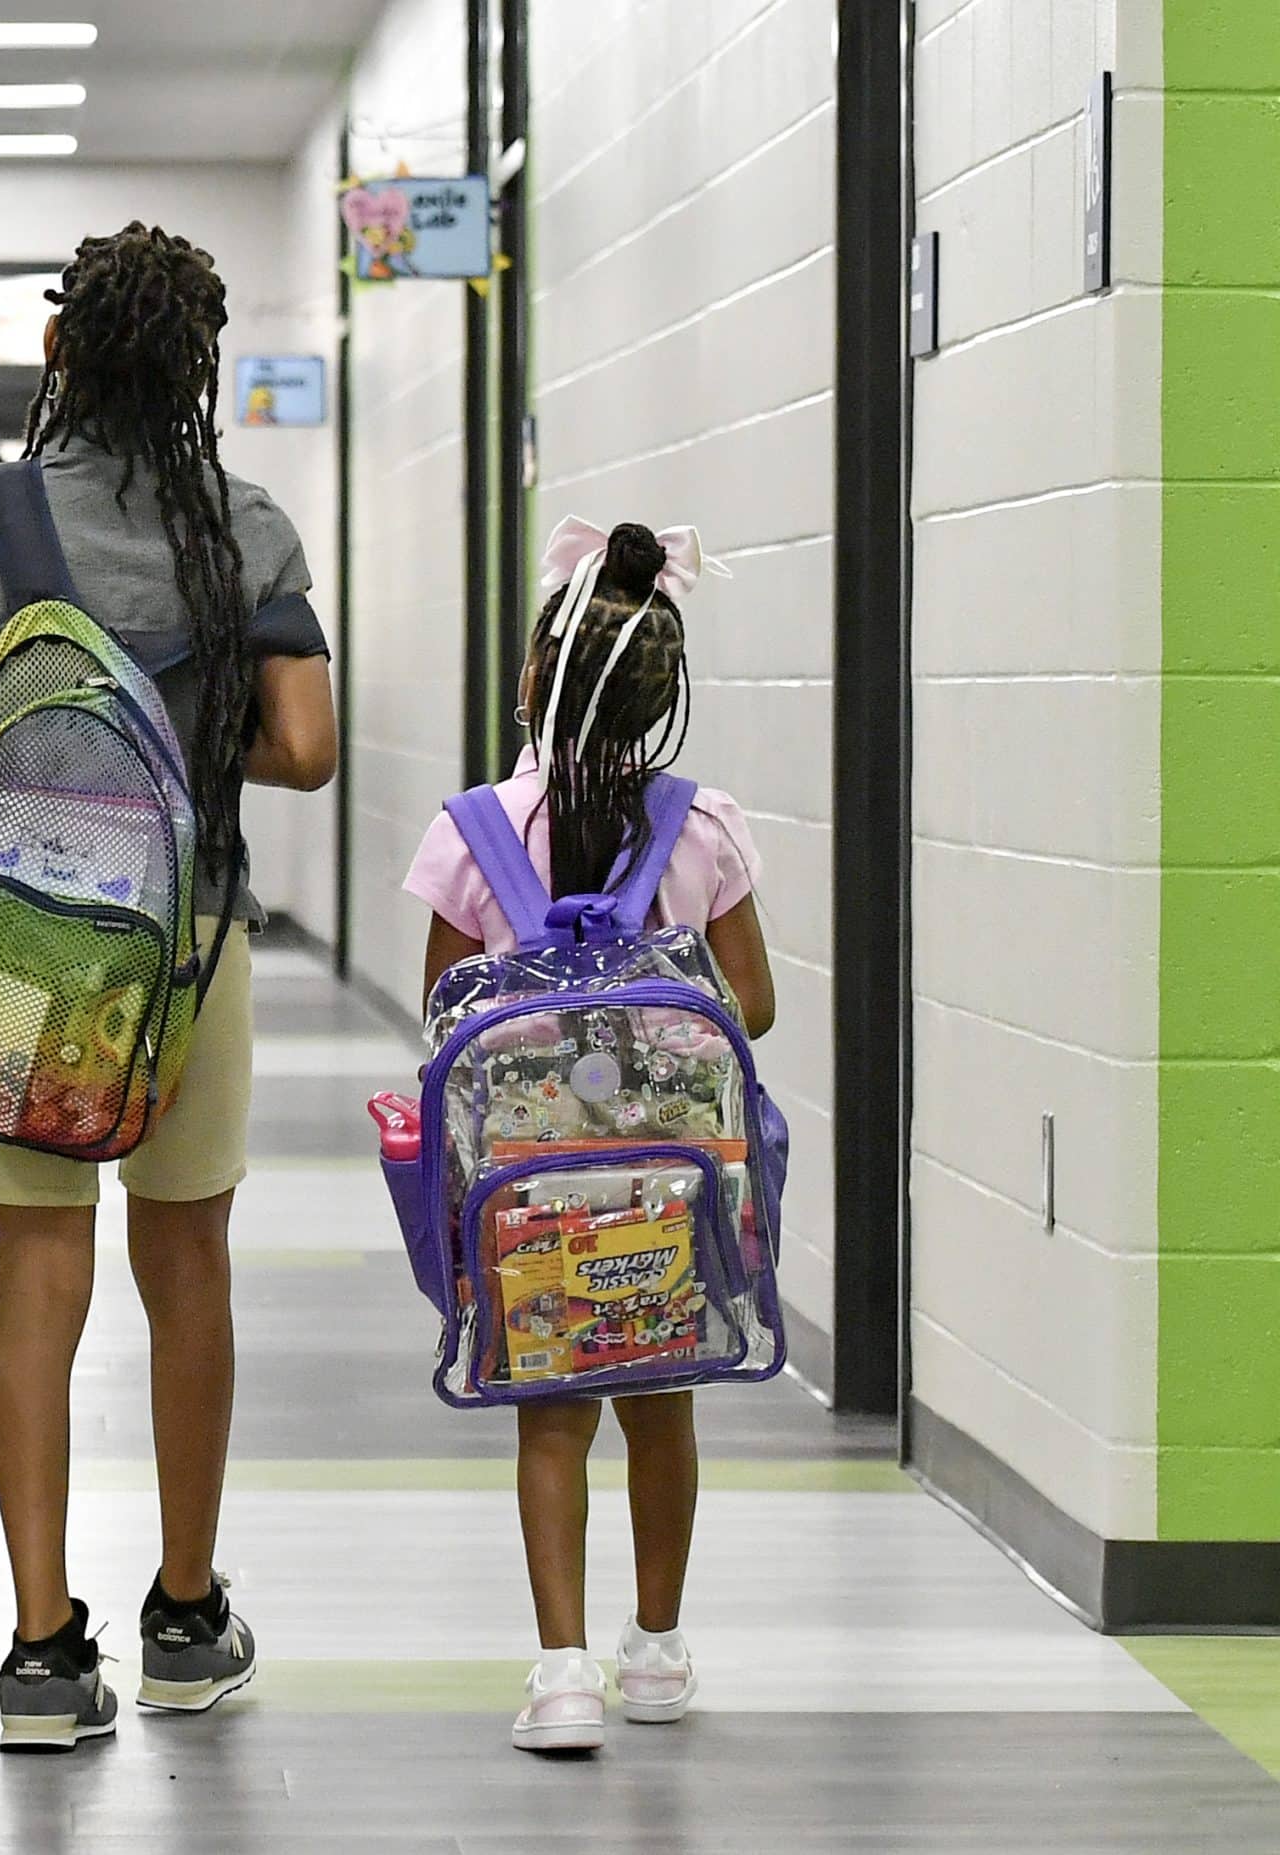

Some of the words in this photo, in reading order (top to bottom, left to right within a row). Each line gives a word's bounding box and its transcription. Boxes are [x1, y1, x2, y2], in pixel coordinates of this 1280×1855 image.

[505, 1212, 521, 1225] 12
[568, 1234, 598, 1255] 10
[577, 1246, 679, 1277] Markers
[166, 1627, 184, 1635] new
[157, 1632, 191, 1643] balance
[24, 1660, 43, 1668] new
[16, 1667, 51, 1676] balance
